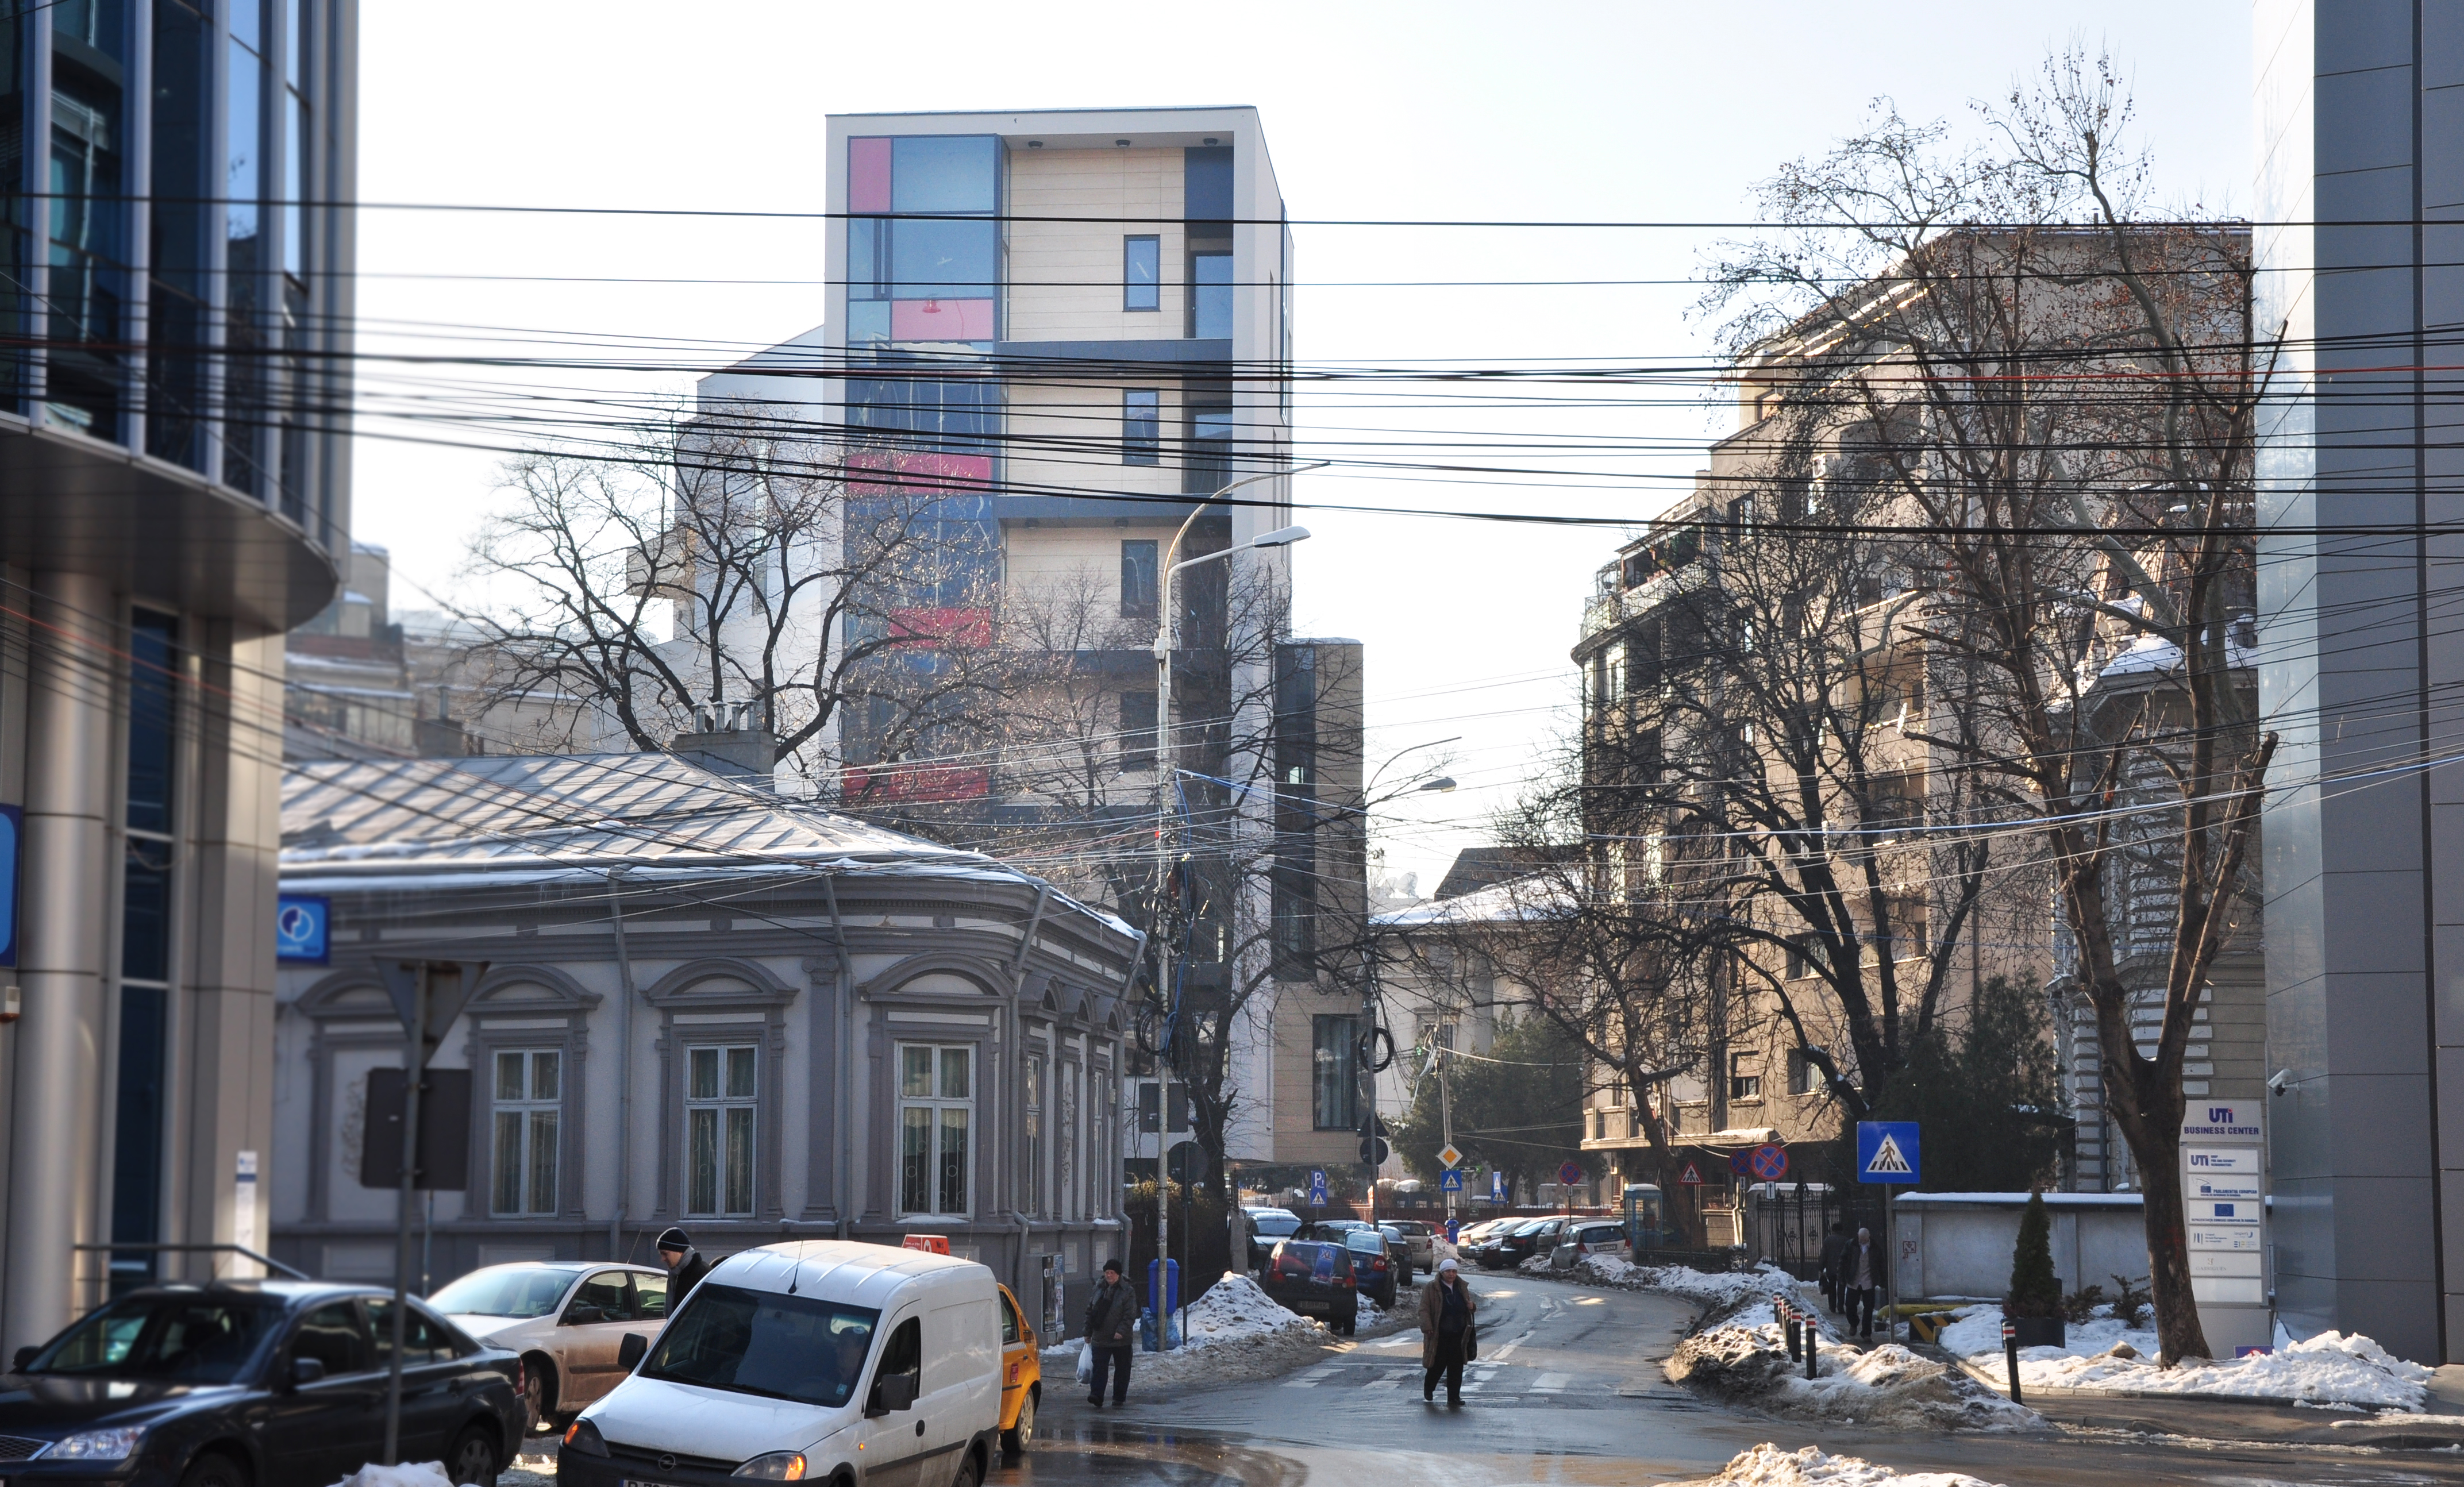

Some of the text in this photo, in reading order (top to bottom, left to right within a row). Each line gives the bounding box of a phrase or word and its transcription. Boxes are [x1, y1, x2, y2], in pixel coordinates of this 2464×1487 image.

[2184, 1126, 2259, 1135] BUSINESS CENTER
[1314, 1172, 1322, 1187] P
